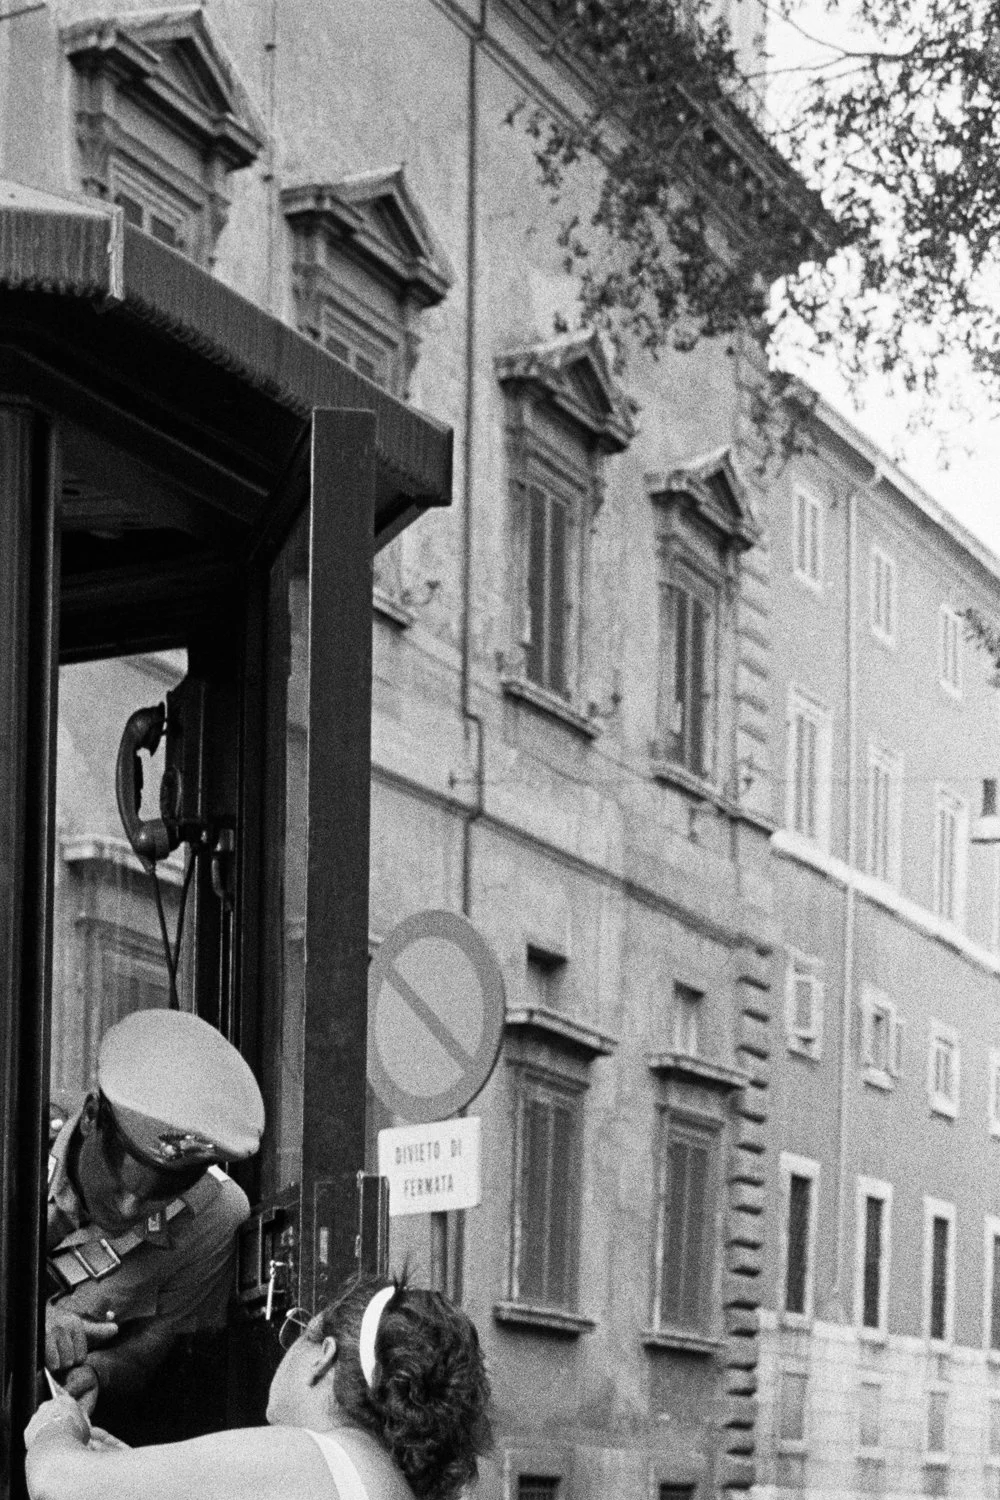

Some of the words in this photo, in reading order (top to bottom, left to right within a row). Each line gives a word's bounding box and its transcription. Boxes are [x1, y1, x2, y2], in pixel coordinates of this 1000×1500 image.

[395, 1140, 441, 1165] DIVIETO
[450, 1138, 462, 1158] DI
[403, 1173, 454, 1197] FERMATA
